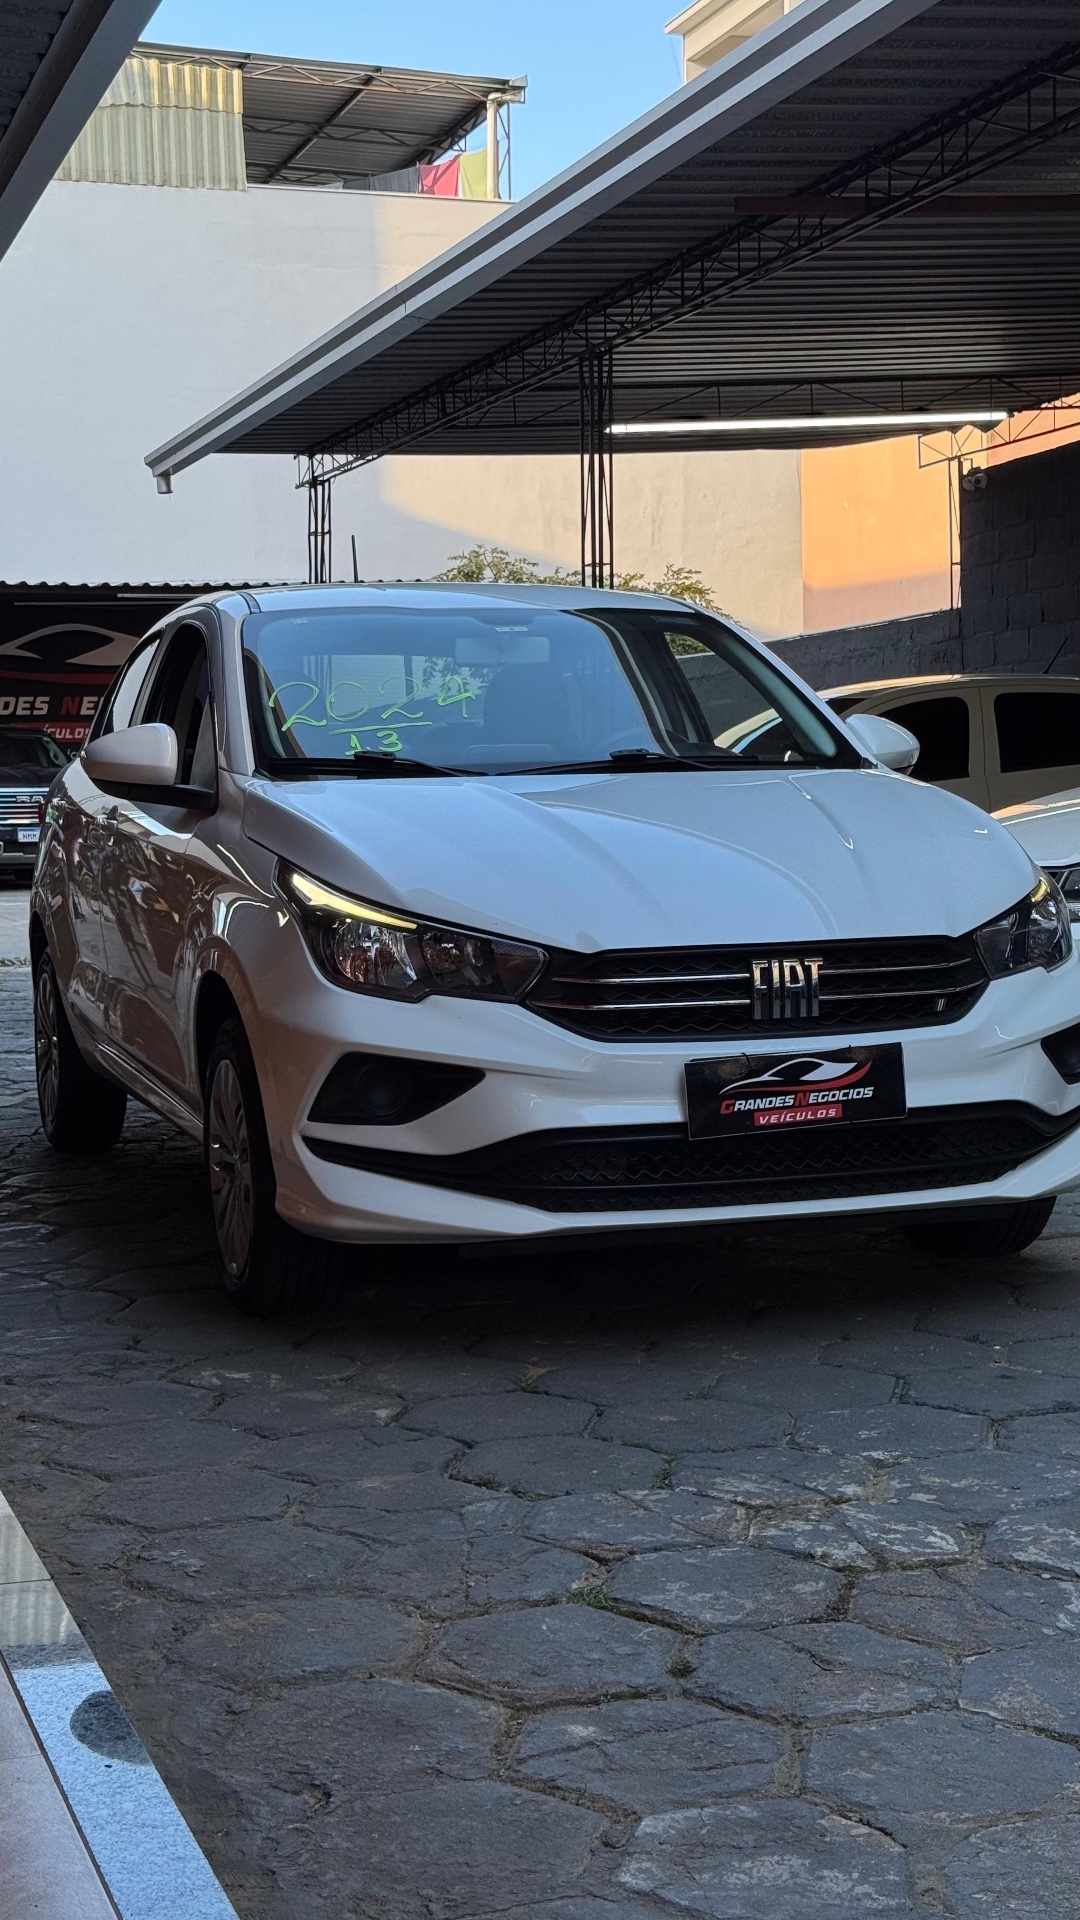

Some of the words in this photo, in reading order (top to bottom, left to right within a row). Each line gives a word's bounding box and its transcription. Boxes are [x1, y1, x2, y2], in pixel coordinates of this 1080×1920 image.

[60, 696, 104, 716] NE
[268, 676, 476, 731] 2024
[344, 730, 403, 756] 1.3
[751, 957, 823, 1020] FIAT
[720, 1094, 796, 1115] GRANDES
[759, 1108, 837, 1124] VEÍCULOS
